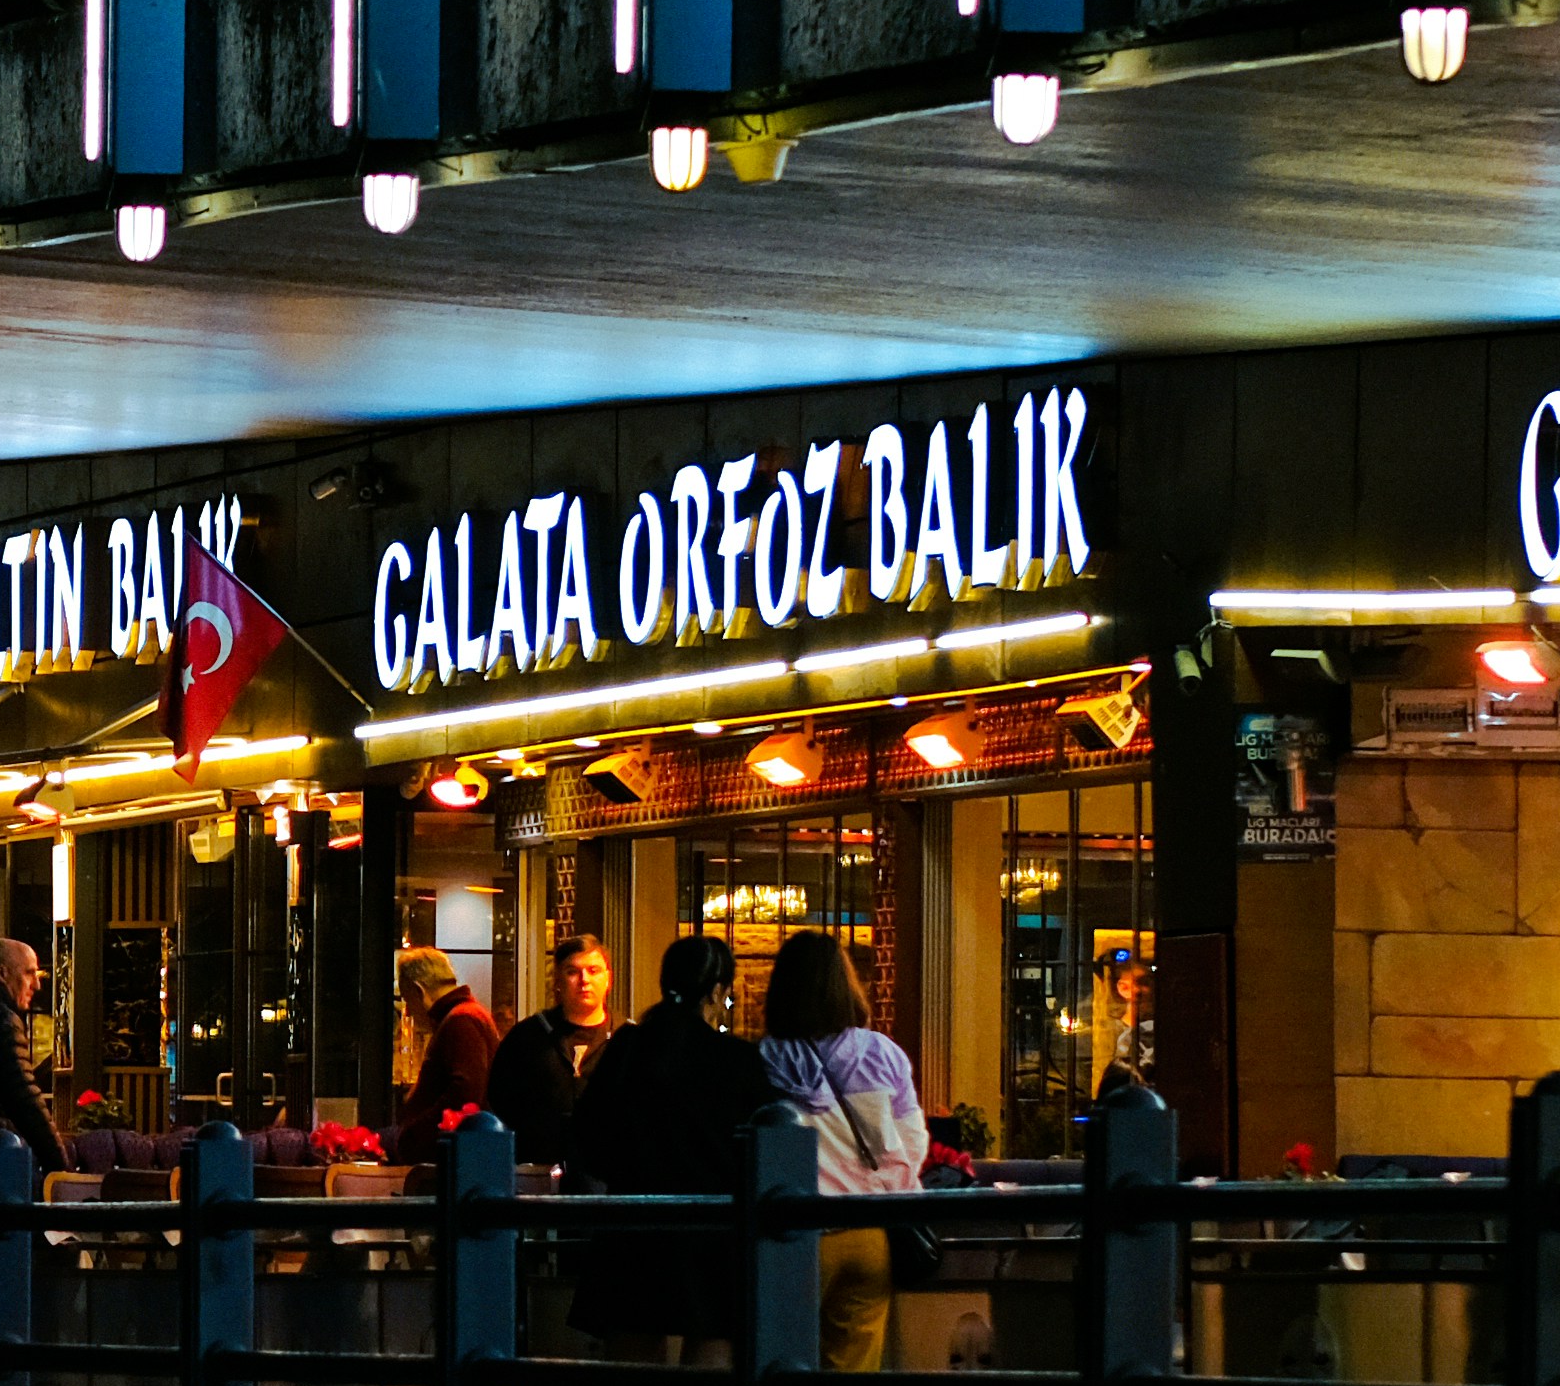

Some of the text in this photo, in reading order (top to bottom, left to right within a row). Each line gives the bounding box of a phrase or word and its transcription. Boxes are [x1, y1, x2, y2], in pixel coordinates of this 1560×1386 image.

[374, 385, 1092, 691] GALATA ORFOZ BALIK
[1244, 828, 1325, 844] BURADA!
